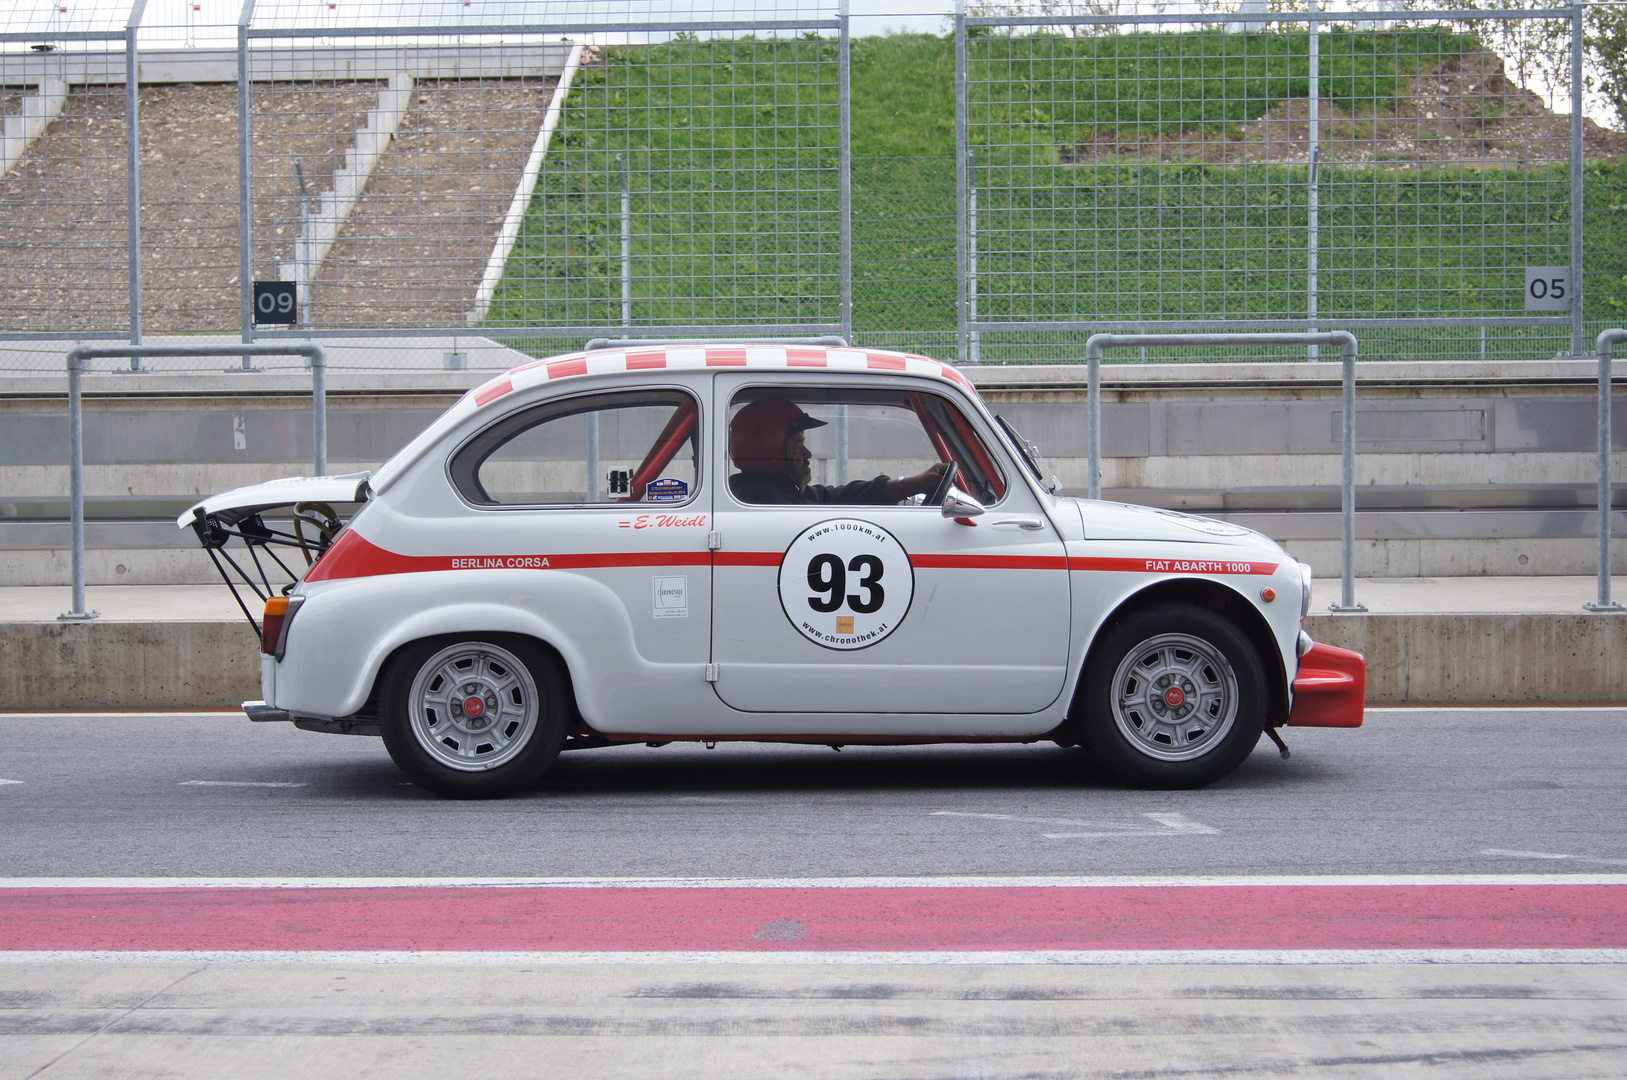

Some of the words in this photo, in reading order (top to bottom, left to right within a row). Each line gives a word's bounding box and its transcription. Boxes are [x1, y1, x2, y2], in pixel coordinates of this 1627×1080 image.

[1530, 278, 1565, 300] 05
[258, 292, 293, 314] 09
[807, 523, 886, 543] www.1000km.at
[451, 558, 504, 569] BERLINA
[506, 557, 550, 568] CORSA
[1145, 560, 1171, 571] FIAT
[1173, 561, 1222, 572] ABARTH
[1225, 562, 1252, 573] 1000
[807, 553, 885, 614] 93
[802, 621, 888, 645] www.chronothek.at
